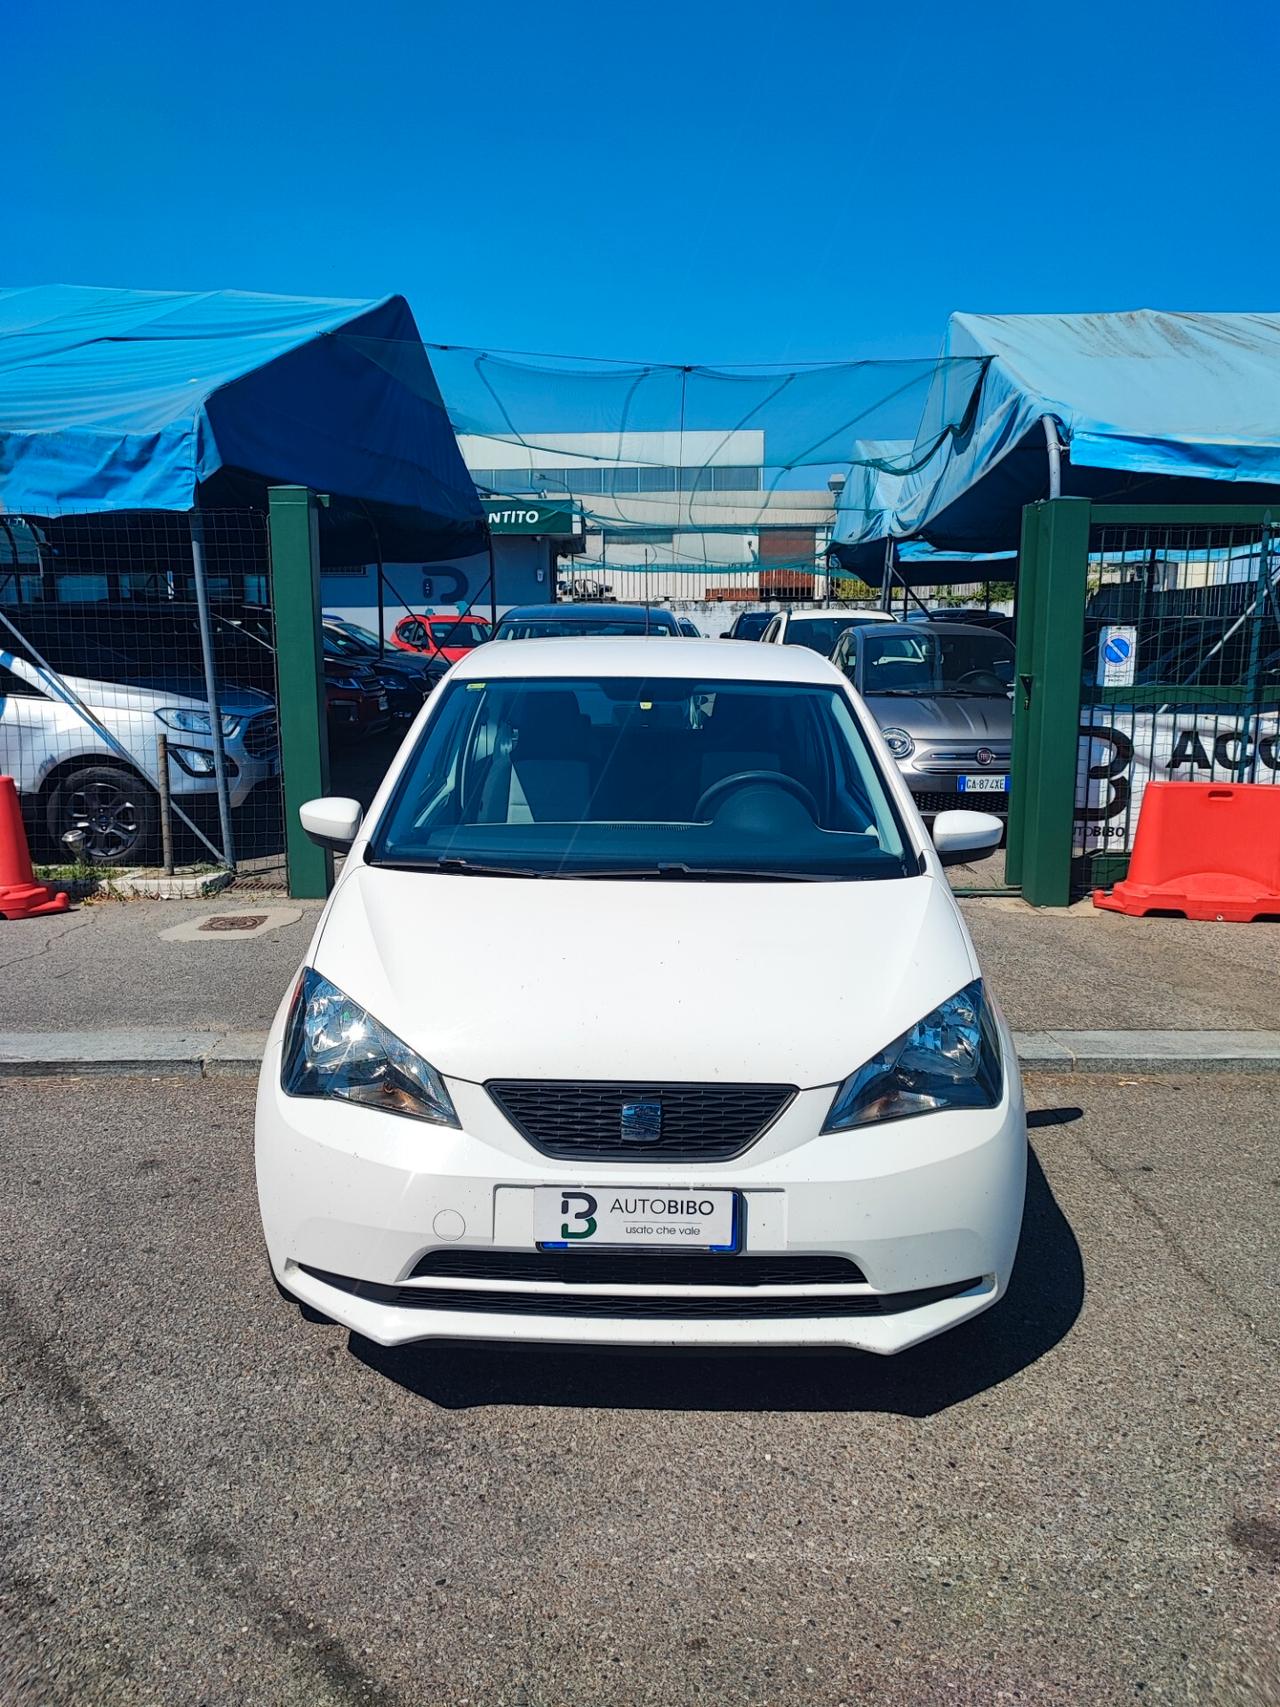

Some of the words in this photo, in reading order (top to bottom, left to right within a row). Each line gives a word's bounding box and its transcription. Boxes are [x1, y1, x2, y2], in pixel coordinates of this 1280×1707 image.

[488, 510, 539, 524] NTITO
[610, 1198, 714, 1216] AUTOBIBO
[625, 1226, 654, 1236] usato
[656, 1227, 677, 1236] che
[679, 1227, 701, 1236] vale
